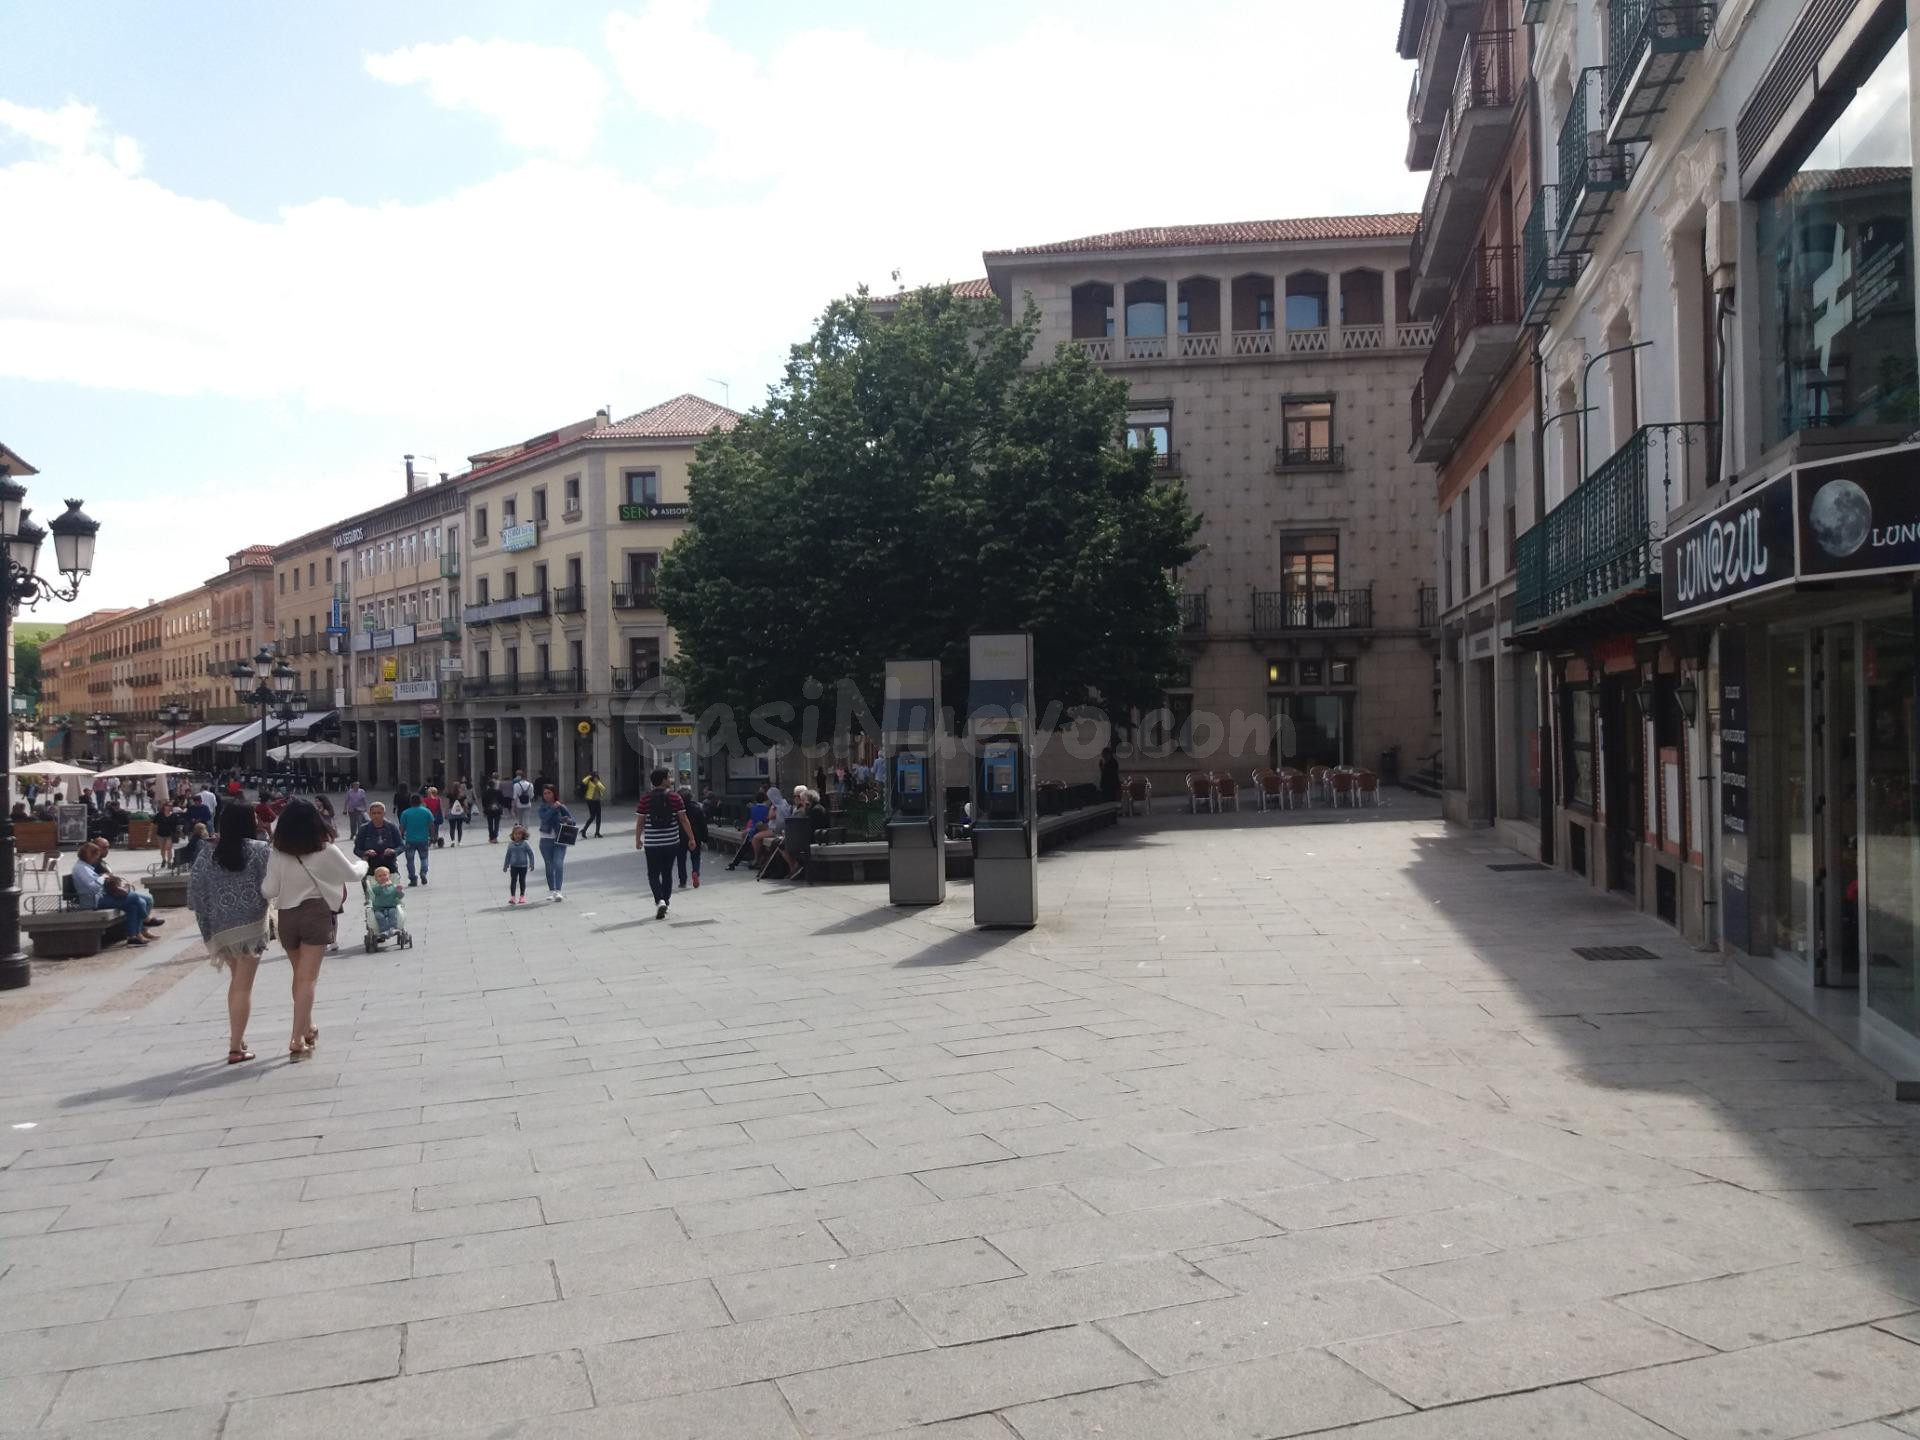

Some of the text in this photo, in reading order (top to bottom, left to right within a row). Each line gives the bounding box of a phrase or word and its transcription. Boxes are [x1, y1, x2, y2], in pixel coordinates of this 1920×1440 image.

[622, 506, 649, 519] SEN
[343, 528, 364, 544] SEGUROS
[1872, 522, 1920, 546] LUN
[400, 681, 429, 694] PREVENTIVA
